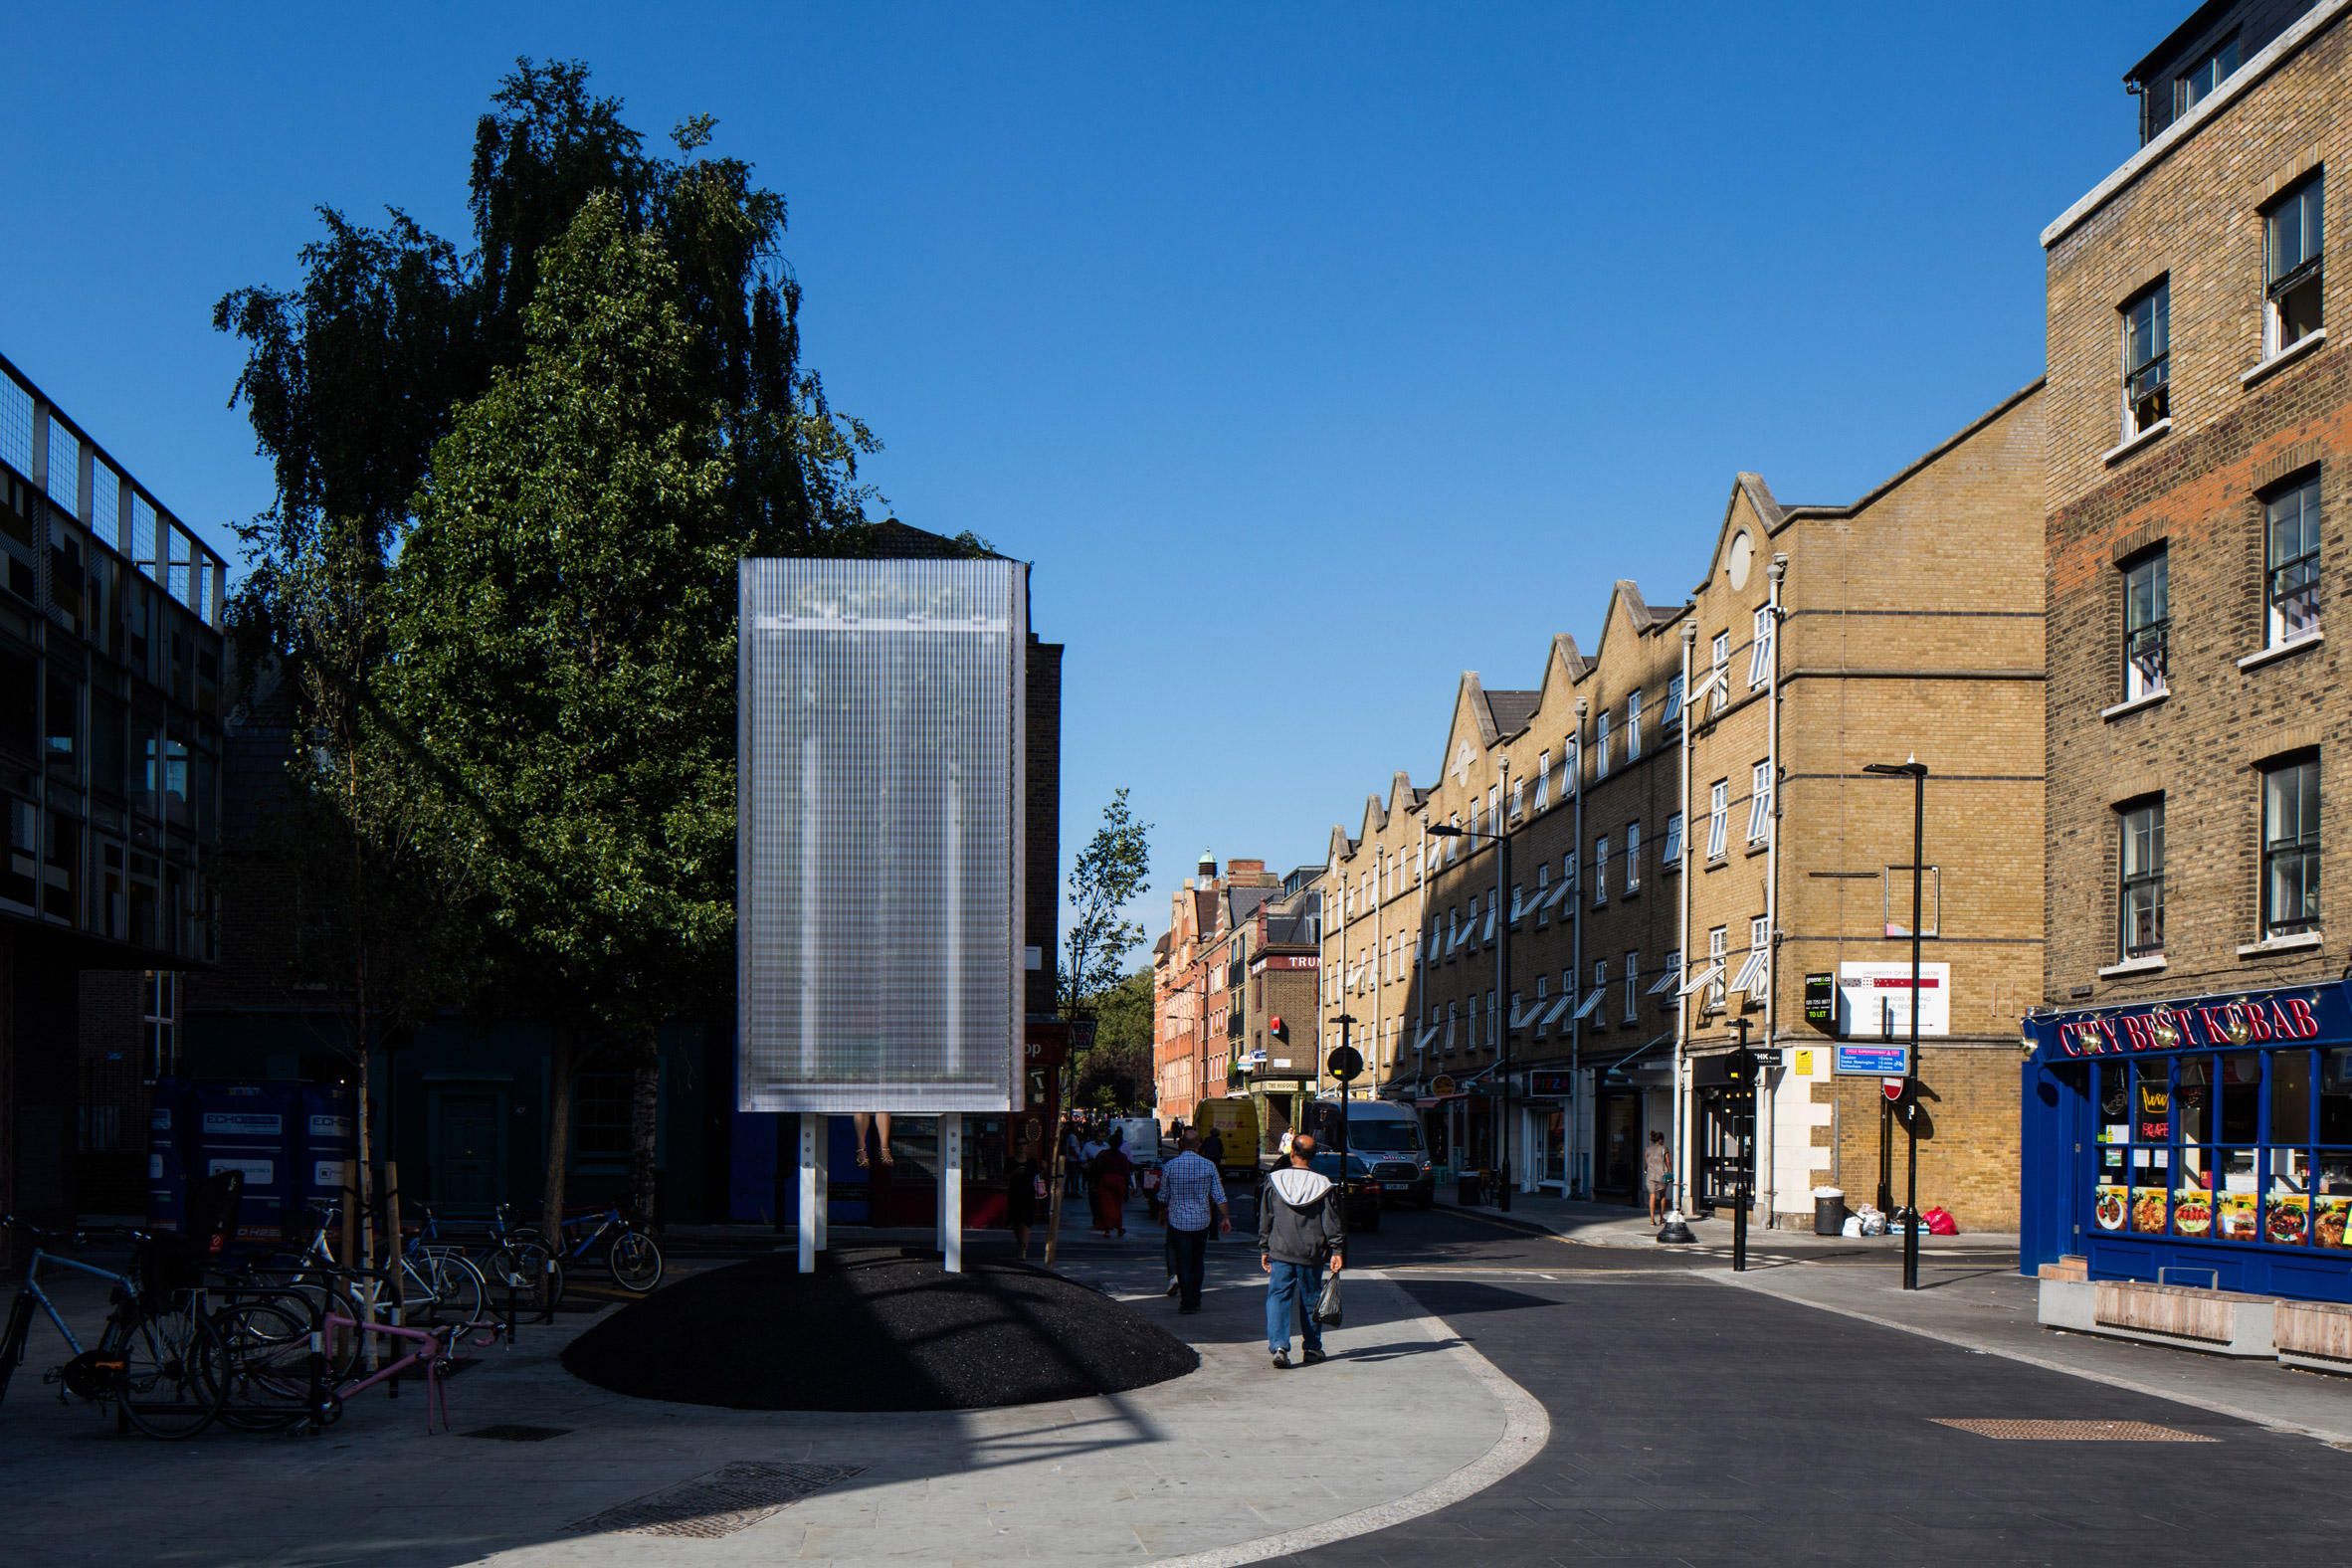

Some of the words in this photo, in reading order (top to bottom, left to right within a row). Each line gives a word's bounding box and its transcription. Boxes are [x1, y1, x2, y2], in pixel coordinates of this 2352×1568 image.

[2059, 1019, 2123, 1057] CITY
[2122, 1010, 2198, 1052] BEST
[2198, 998, 2318, 1045] KEBAB
[1534, 1078, 1570, 1090] PIZZA
[207, 1115, 244, 1124] ECHO
[2142, 1122, 2169, 1137] FALAFE
